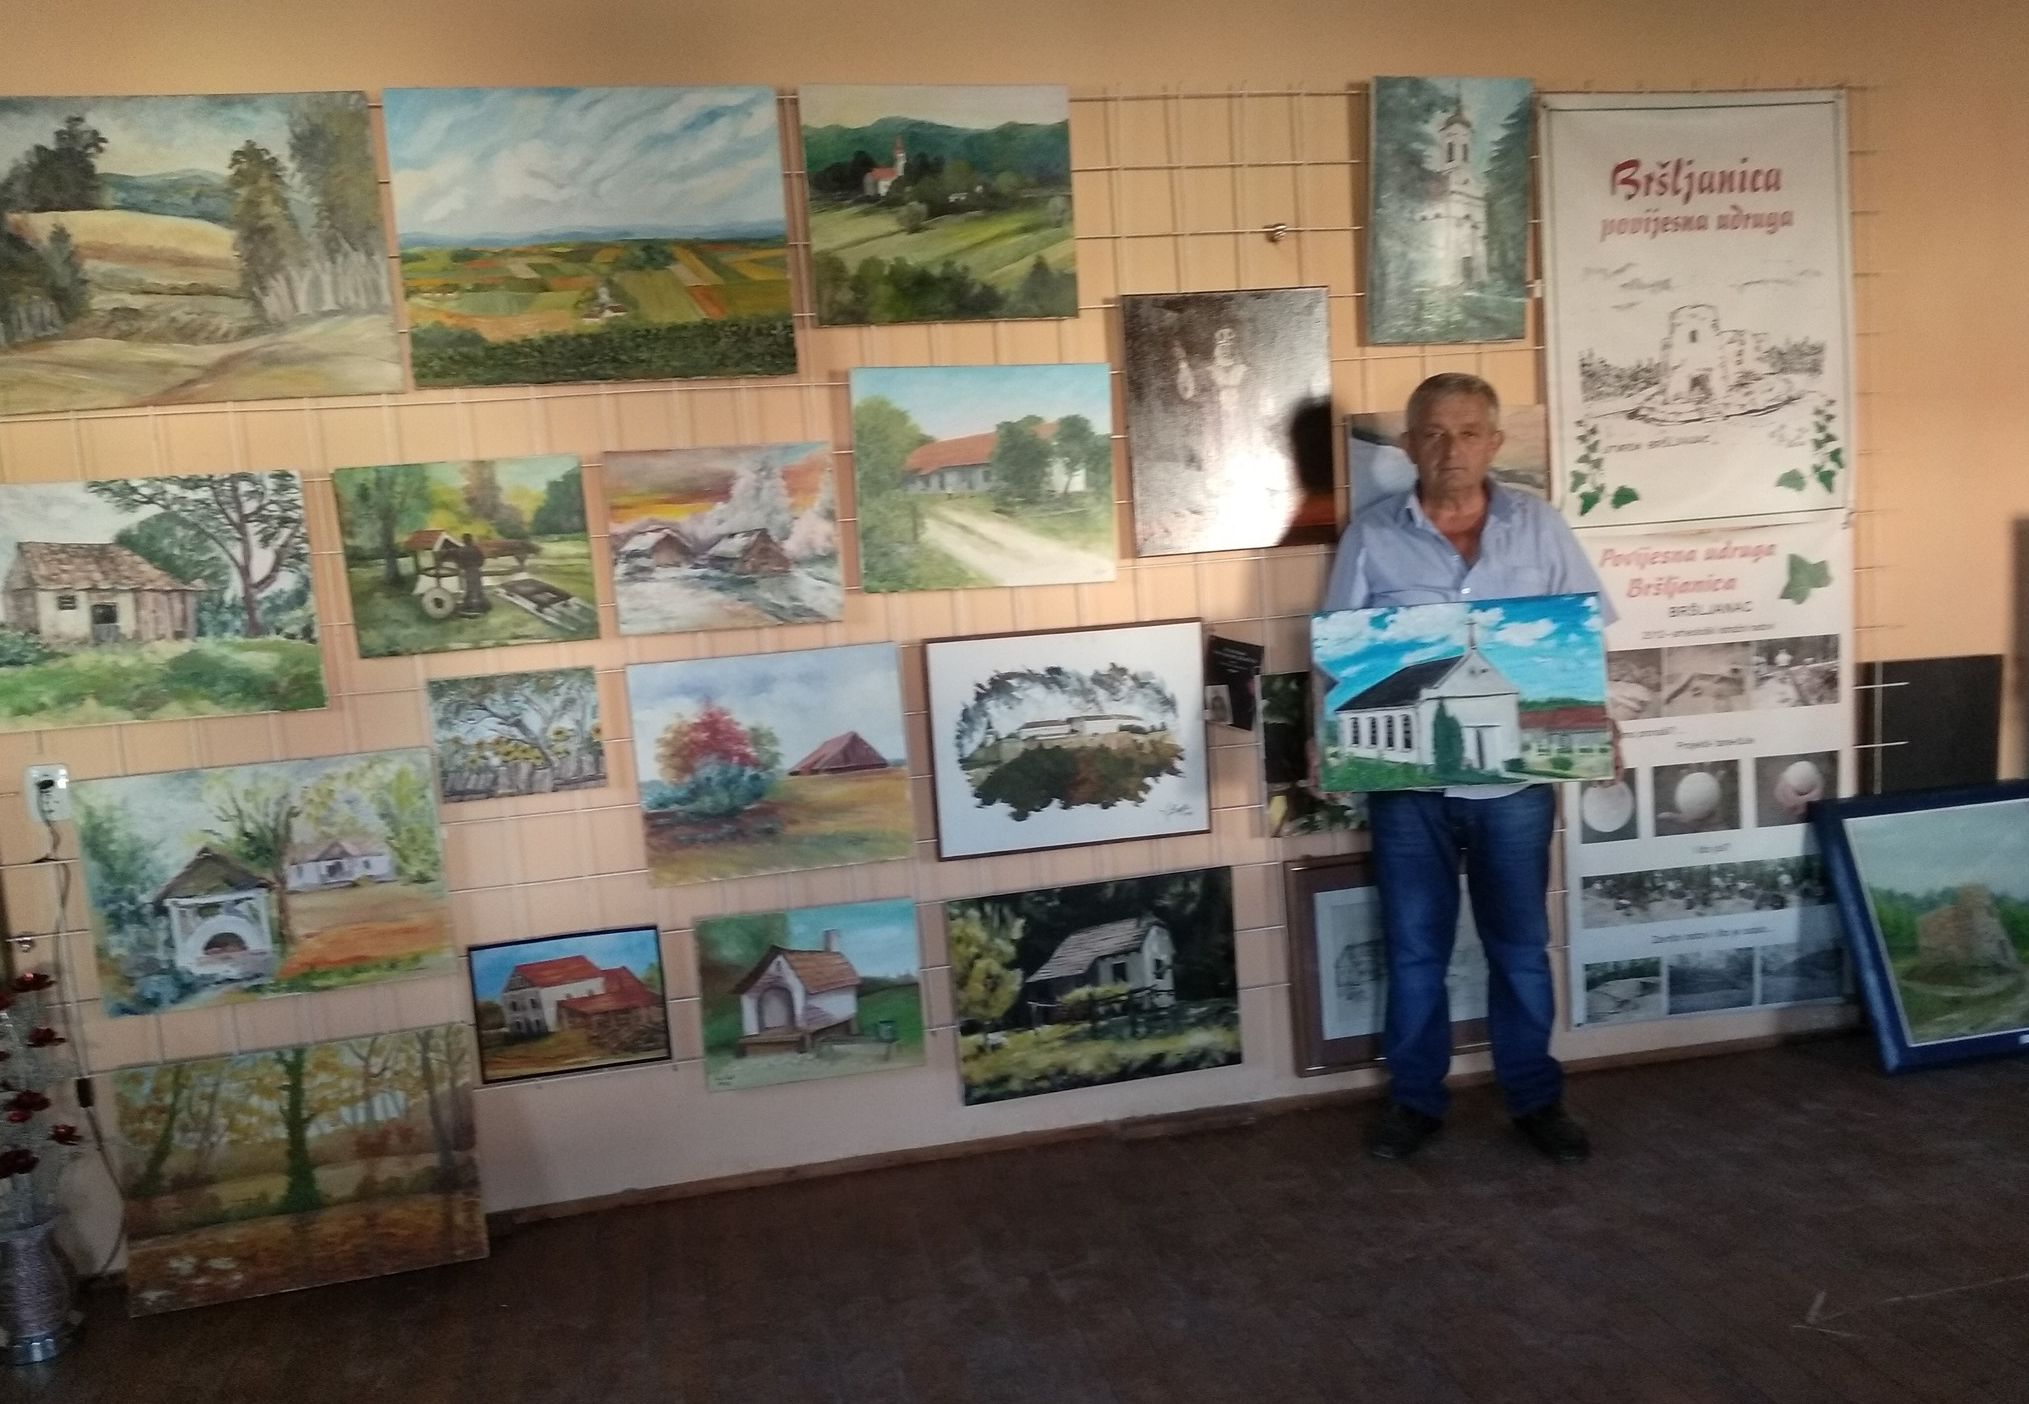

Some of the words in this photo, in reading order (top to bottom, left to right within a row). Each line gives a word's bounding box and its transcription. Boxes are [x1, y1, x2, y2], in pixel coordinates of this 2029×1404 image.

[1610, 156, 1783, 206] Bršljanica
[1600, 208, 1709, 242] povijesna
[1715, 204, 1795, 235] udruga
[1599, 546, 1698, 571] Povijesna
